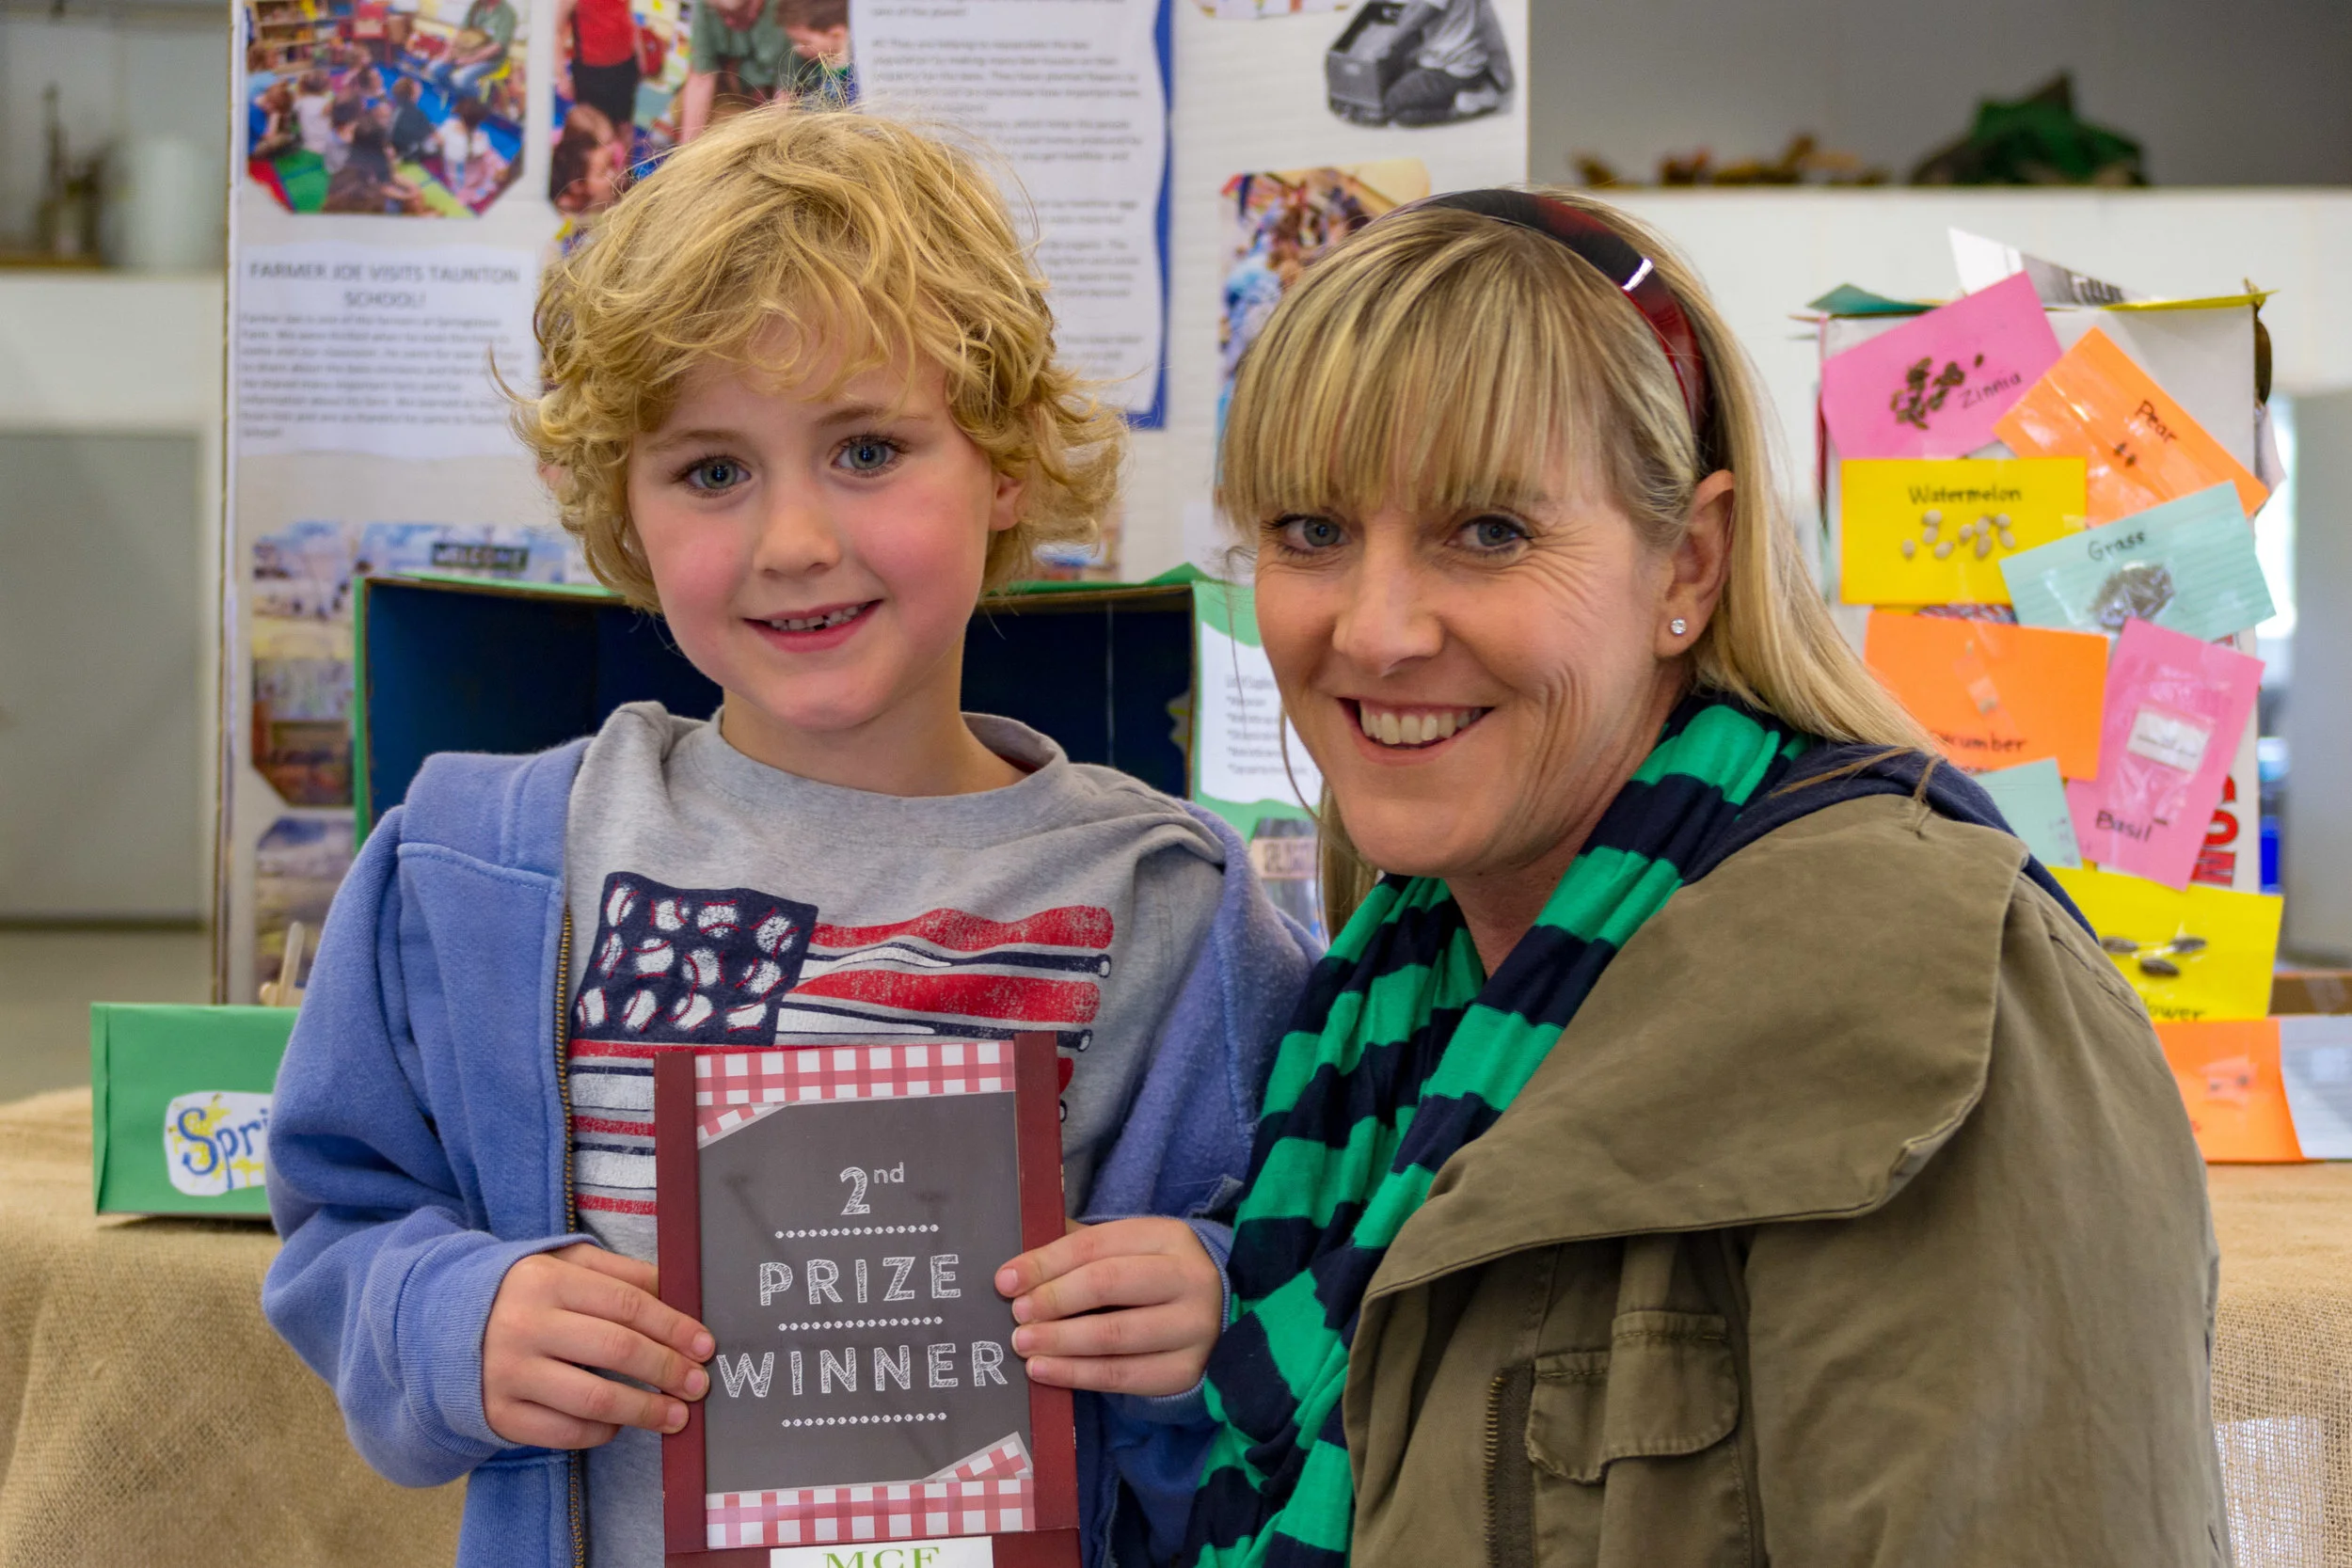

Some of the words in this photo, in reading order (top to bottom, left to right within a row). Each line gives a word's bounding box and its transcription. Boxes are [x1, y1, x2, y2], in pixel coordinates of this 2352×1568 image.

[248, 261, 326, 280] FARMER
[332, 263, 361, 281] JOE
[370, 264, 423, 283] VISITS
[429, 265, 521, 285] TAUNTON
[1958, 372, 2023, 409] Zinnia
[2135, 400, 2178, 443] Pear
[1907, 483, 2023, 505] Watermelon
[2087, 530, 2146, 562] Grass
[2094, 809, 2153, 843] Basil
[758, 1253, 962, 1306] PRIZE
[716, 1340, 1009, 1400] WINNER
